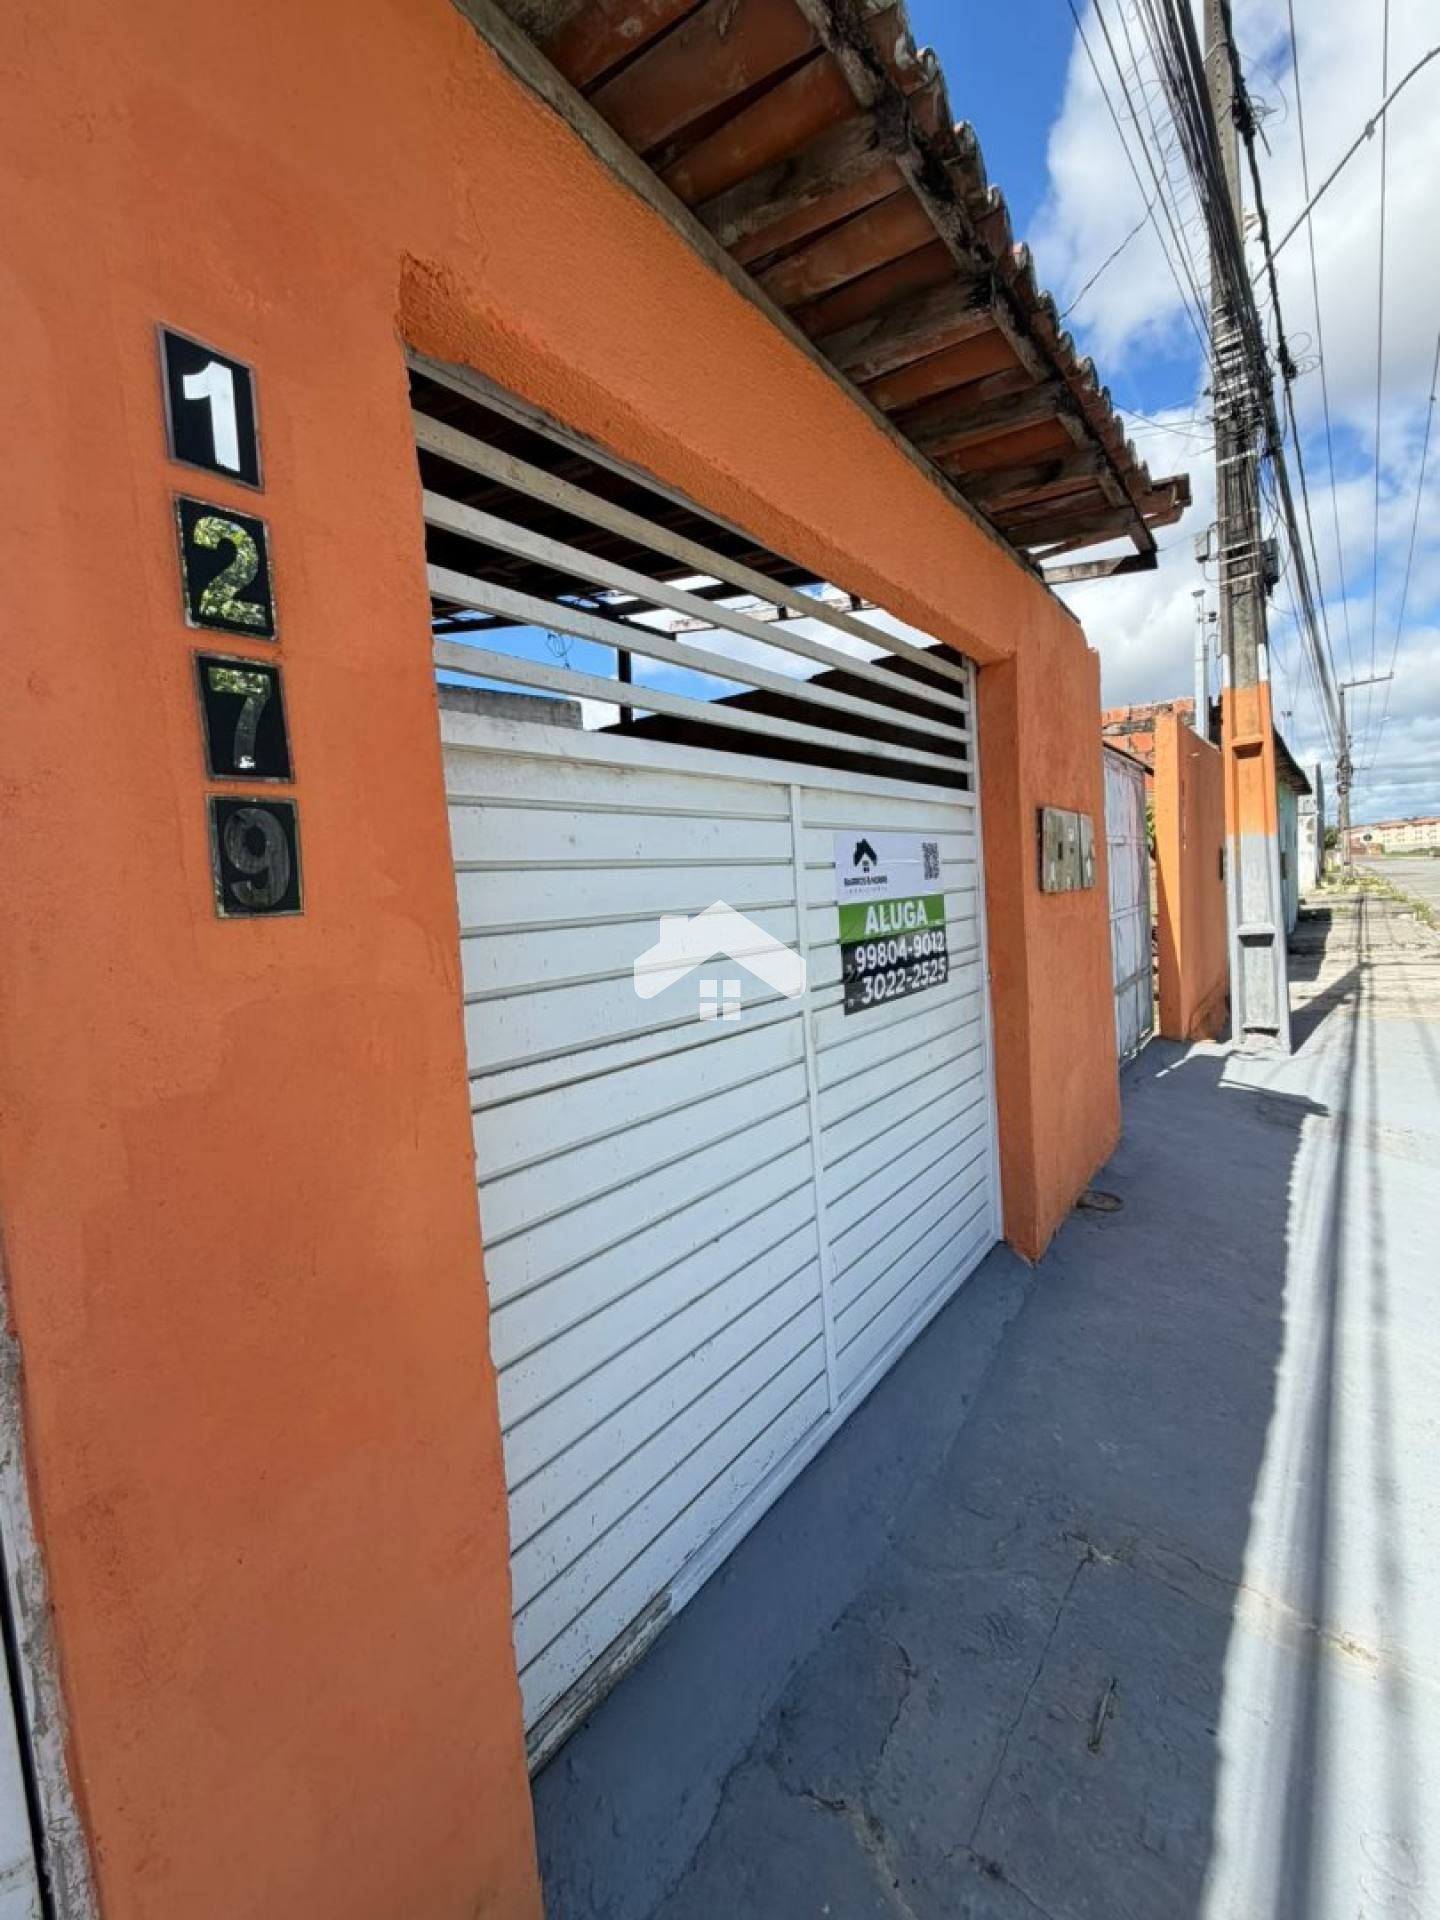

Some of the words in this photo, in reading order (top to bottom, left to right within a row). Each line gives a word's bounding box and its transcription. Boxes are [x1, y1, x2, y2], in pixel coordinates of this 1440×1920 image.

[864, 899, 928, 936] ALUGA
[855, 931, 945, 973] 99804-9012
[861, 958, 946, 1004] 3022-2525
